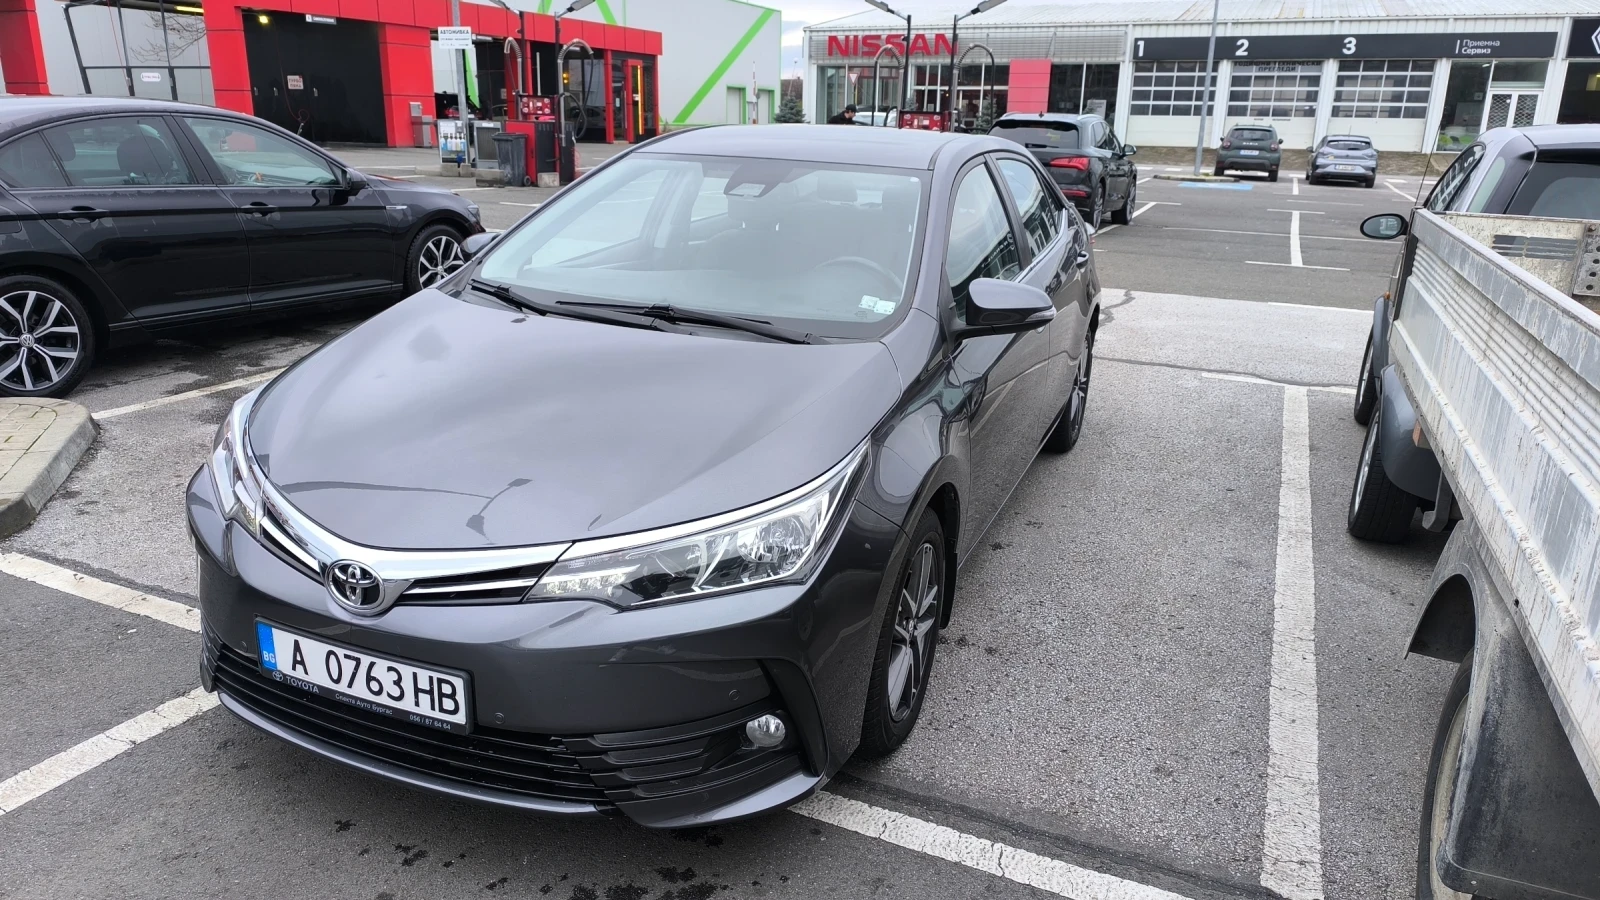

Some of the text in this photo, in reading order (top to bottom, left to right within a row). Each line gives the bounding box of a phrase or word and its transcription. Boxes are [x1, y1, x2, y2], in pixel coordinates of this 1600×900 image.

[827, 32, 959, 57] NISSAN
[1137, 40, 1145, 57] 1
[1235, 38, 1249, 56] 2
[1342, 37, 1357, 55] 3
[1461, 47, 1492, 55] Сервиз
[1462, 39, 1500, 48] Приемна
[263, 651, 276, 664] BG
[285, 676, 320, 694] TOYOTA
[292, 639, 460, 716] A 0763 HB
[409, 714, 421, 723] 056
